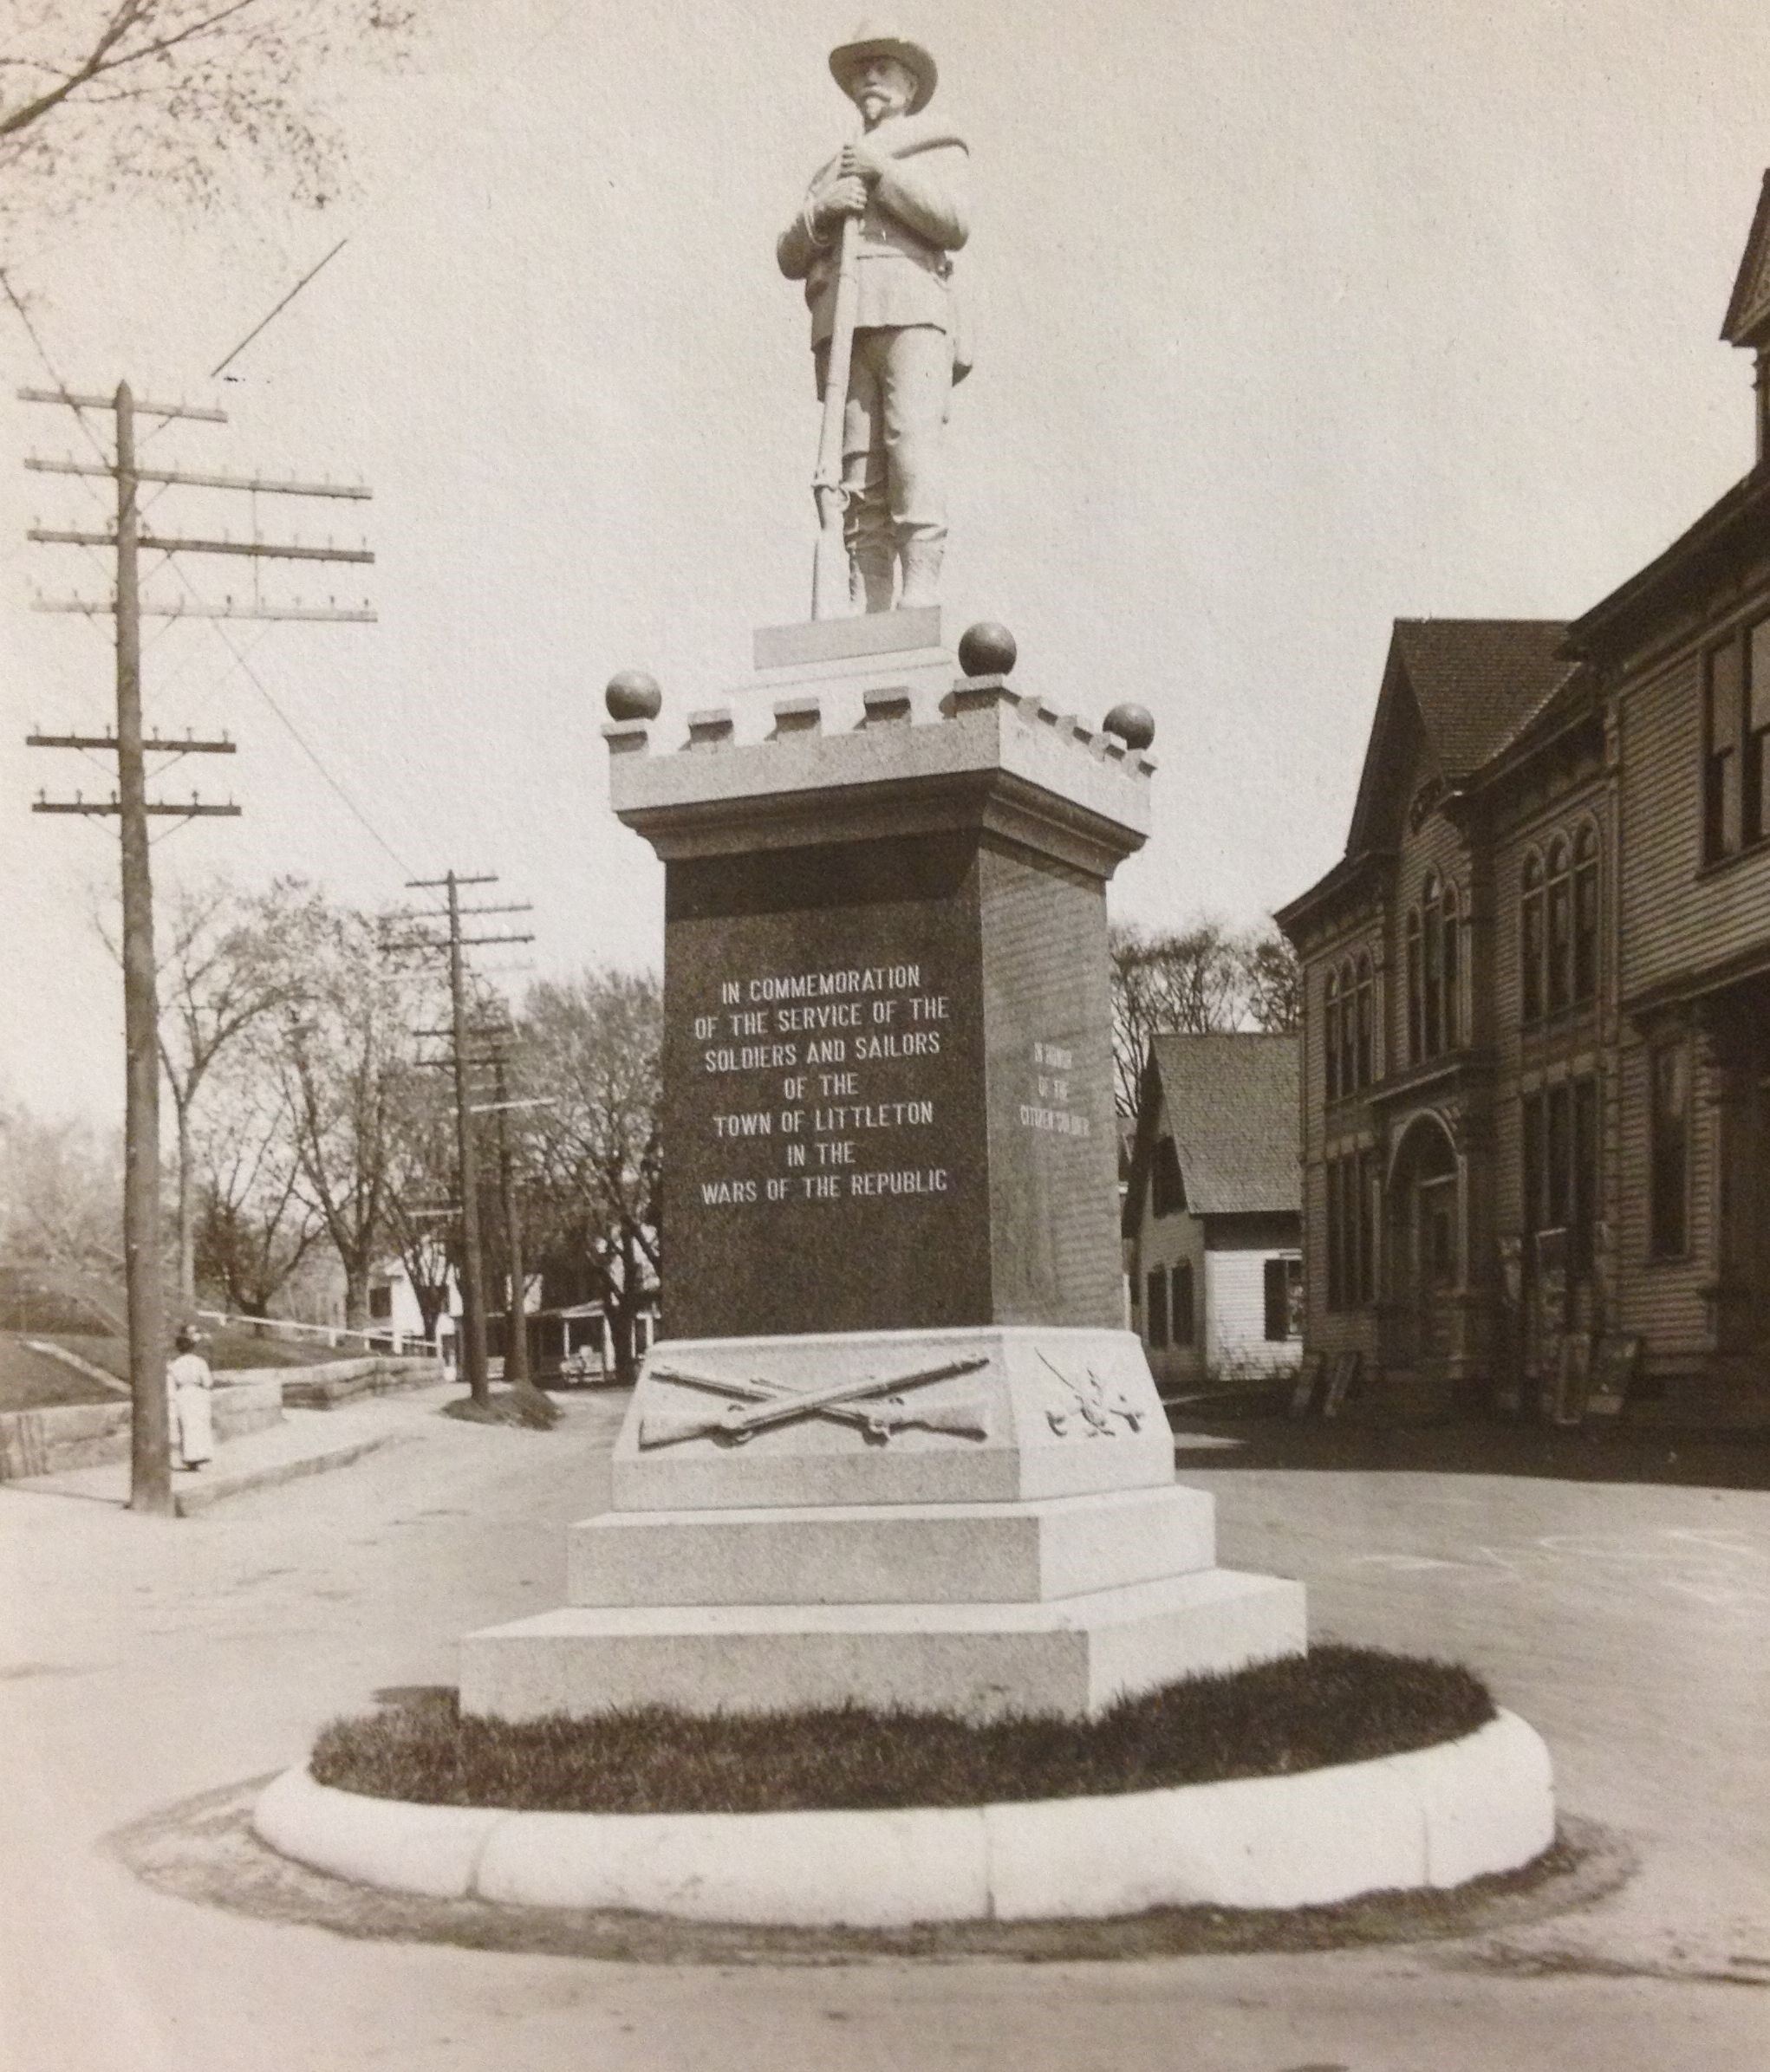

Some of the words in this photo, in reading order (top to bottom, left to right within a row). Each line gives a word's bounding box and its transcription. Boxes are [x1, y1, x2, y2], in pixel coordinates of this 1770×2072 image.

[722, 982, 740, 1004] IN
[751, 965, 921, 1002] COMMEMORATION
[695, 1017, 719, 1039] OF
[732, 1012, 768, 1036] THE
[779, 1004, 862, 1032] SERVICE
[873, 1000, 897, 1023] OF
[909, 997, 950, 1021] THE
[705, 1045, 797, 1072] SOLDIERS
[806, 1040, 845, 1063] AND
[856, 1031, 940, 1060] SAILORS
[784, 1077, 807, 1100] OF
[820, 1072, 859, 1095] THE
[713, 1113, 771, 1137] TOWN
[781, 1110, 804, 1133] OF
[815, 1101, 934, 1131] LITTLETON
[787, 1145, 804, 1166] IN
[816, 1141, 856, 1165] THE
[702, 1180, 757, 1205] WARS
[767, 1179, 791, 1200] OF
[802, 1175, 841, 1198] THE
[851, 1169, 947, 1196] REPUBLIC
